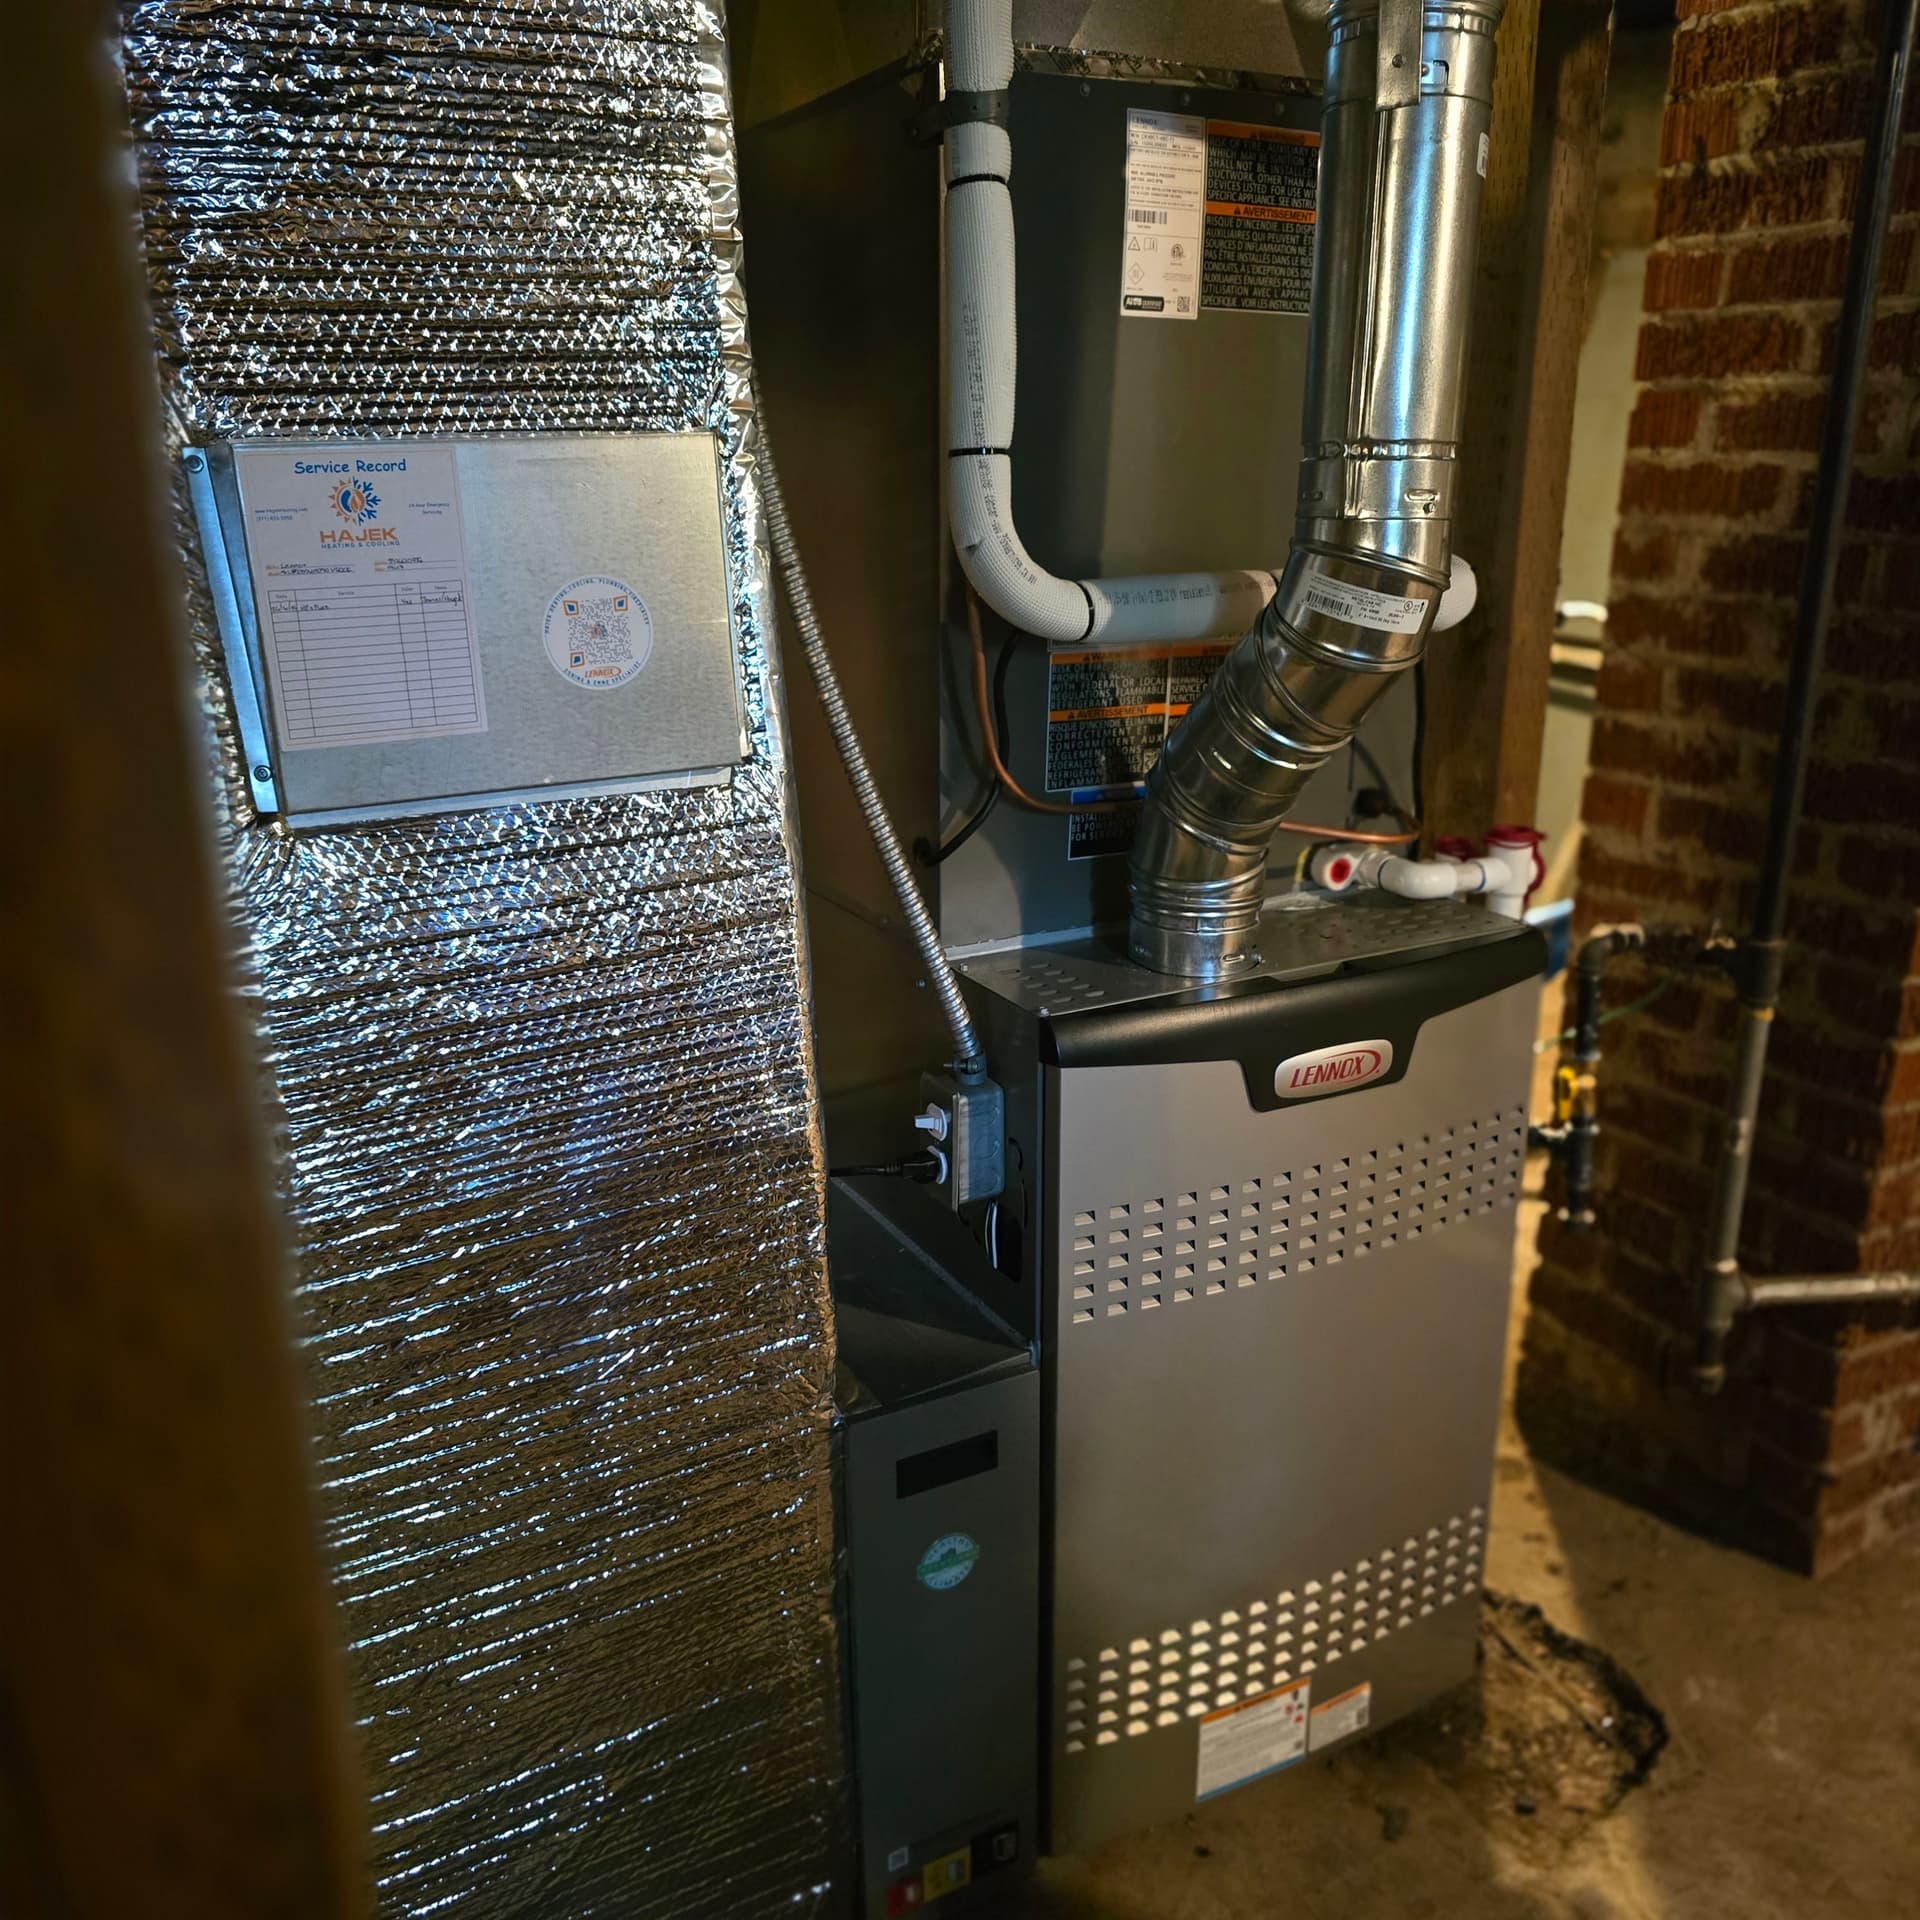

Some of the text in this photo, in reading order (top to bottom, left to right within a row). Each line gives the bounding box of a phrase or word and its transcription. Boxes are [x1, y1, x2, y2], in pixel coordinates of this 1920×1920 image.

[1208, 157, 1233, 170] SHALL
[1236, 160, 1253, 170] NOT
[1208, 178, 1241, 191] DEVICES
[1243, 182, 1267, 194] LISTED
[1271, 185, 1286, 196] FOR
[1287, 186, 1302, 198] USE
[1257, 173, 1282, 185] OTHER
[1284, 176, 1304, 188] THAN
[1305, 178, 1316, 188] AU
[1208, 189, 1237, 202] SPECIFIC
[1278, 197, 1290, 207] SEE
[1291, 198, 1316, 209] INSTRU
[1243, 207, 1314, 222] AVERTISSEMENT
[1206, 215, 1234, 228] RISQUE
[1282, 223, 1294, 233] LES
[1205, 227, 1250, 240] AUXILIAIRES
[1252, 232, 1266, 242] QUI
[1267, 233, 1299, 245] PEUVENT
[1205, 238, 1236, 250] SOURCES
[1204, 249, 1217, 260] PAS
[1272, 255, 1290, 266] DANS
[1291, 257, 1299, 266] LE
[1287, 267, 1299, 277] DES
[1203, 283, 1249, 297] UTILISATION
[1252, 287, 1271, 298] AVEC
[1282, 278, 1301, 289] POUR
[1257, 298, 1268, 308] LES
[294, 458, 407, 474] Service Record
[320, 528, 399, 543] HAJEK
[321, 541, 355, 550] HEATING
[366, 540, 401, 549] COOLING
[1081, 678, 1119, 690] FEDERAL
[1122, 678, 1135, 688] OR
[1139, 676, 1165, 687] LOCAL
[1115, 685, 1165, 698] FLAMMABLE
[1050, 695, 1143, 711] REFRIGERANT USED
[1077, 705, 1149, 719] AVERTISSEMENT
[1049, 725, 1147, 742] CORRECTEMENT ET
[1140, 735, 1163, 745] AUX
[1290, 1055, 1366, 1089] LENNOX
